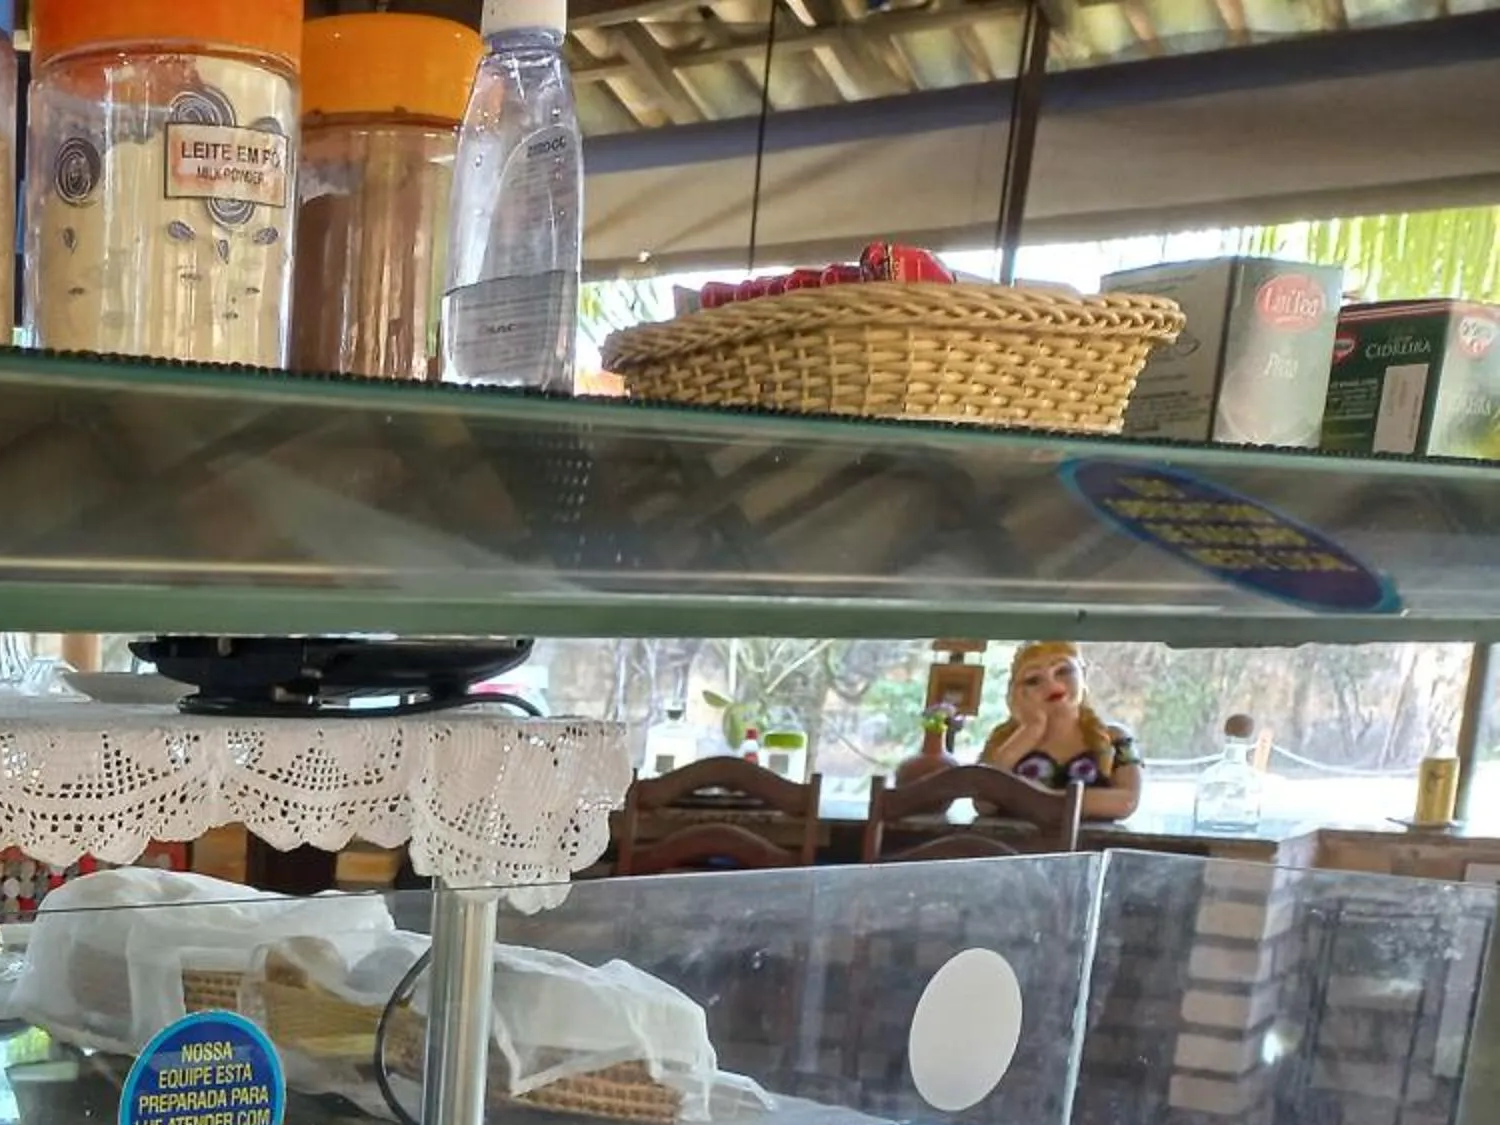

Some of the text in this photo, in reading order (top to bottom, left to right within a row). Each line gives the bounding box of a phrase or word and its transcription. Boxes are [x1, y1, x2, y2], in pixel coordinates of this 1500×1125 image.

[181, 141, 232, 161] LEITE
[236, 145, 259, 164] EM
[181, 1041, 233, 1063] NOSSA
[158, 1066, 213, 1089] EQUIPE
[138, 1085, 269, 1115] PREPARADA PARA
